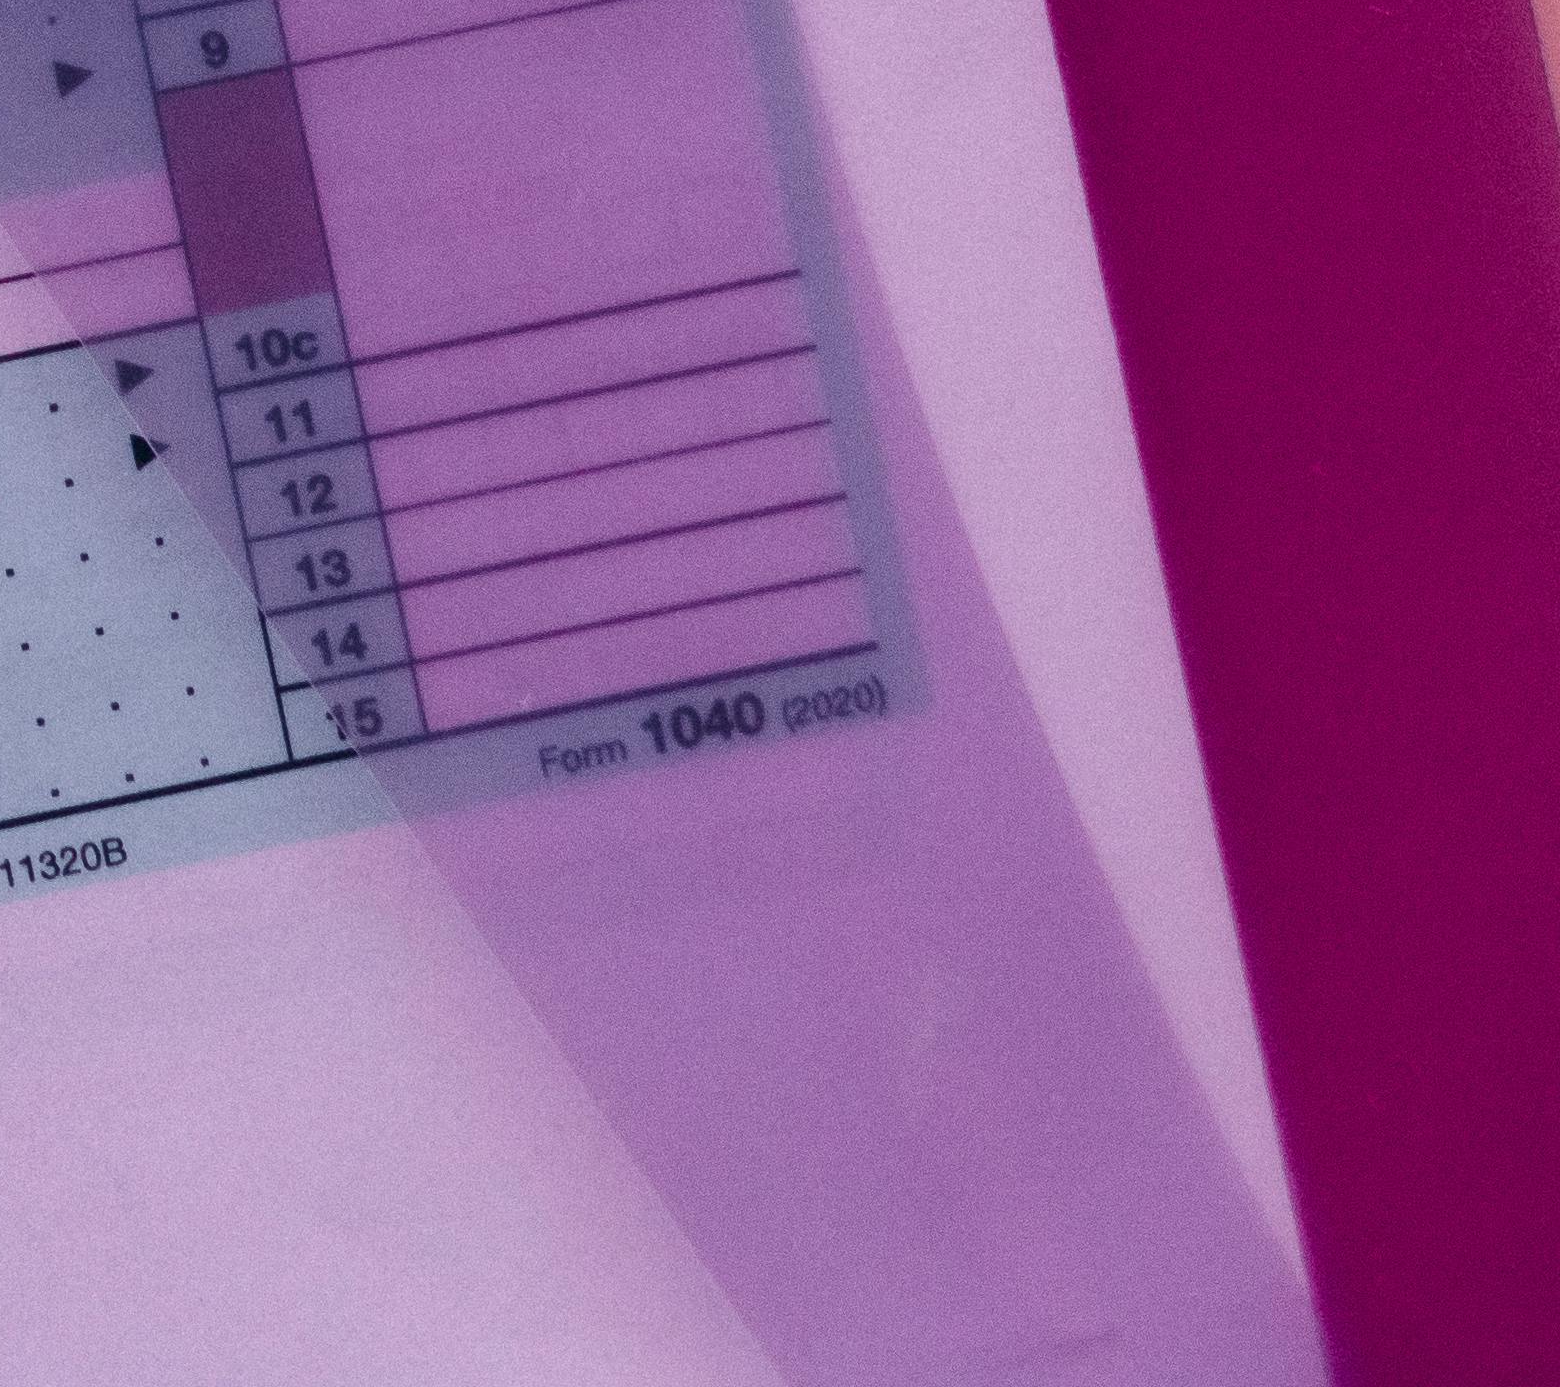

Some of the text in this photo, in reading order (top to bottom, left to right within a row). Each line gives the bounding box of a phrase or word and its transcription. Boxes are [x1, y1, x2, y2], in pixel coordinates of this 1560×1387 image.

[199, 30, 230, 69] 9
[236, 329, 319, 371] 10c
[538, 675, 889, 778] Form 1040 (2020)
[0, 836, 129, 889] 11320B
